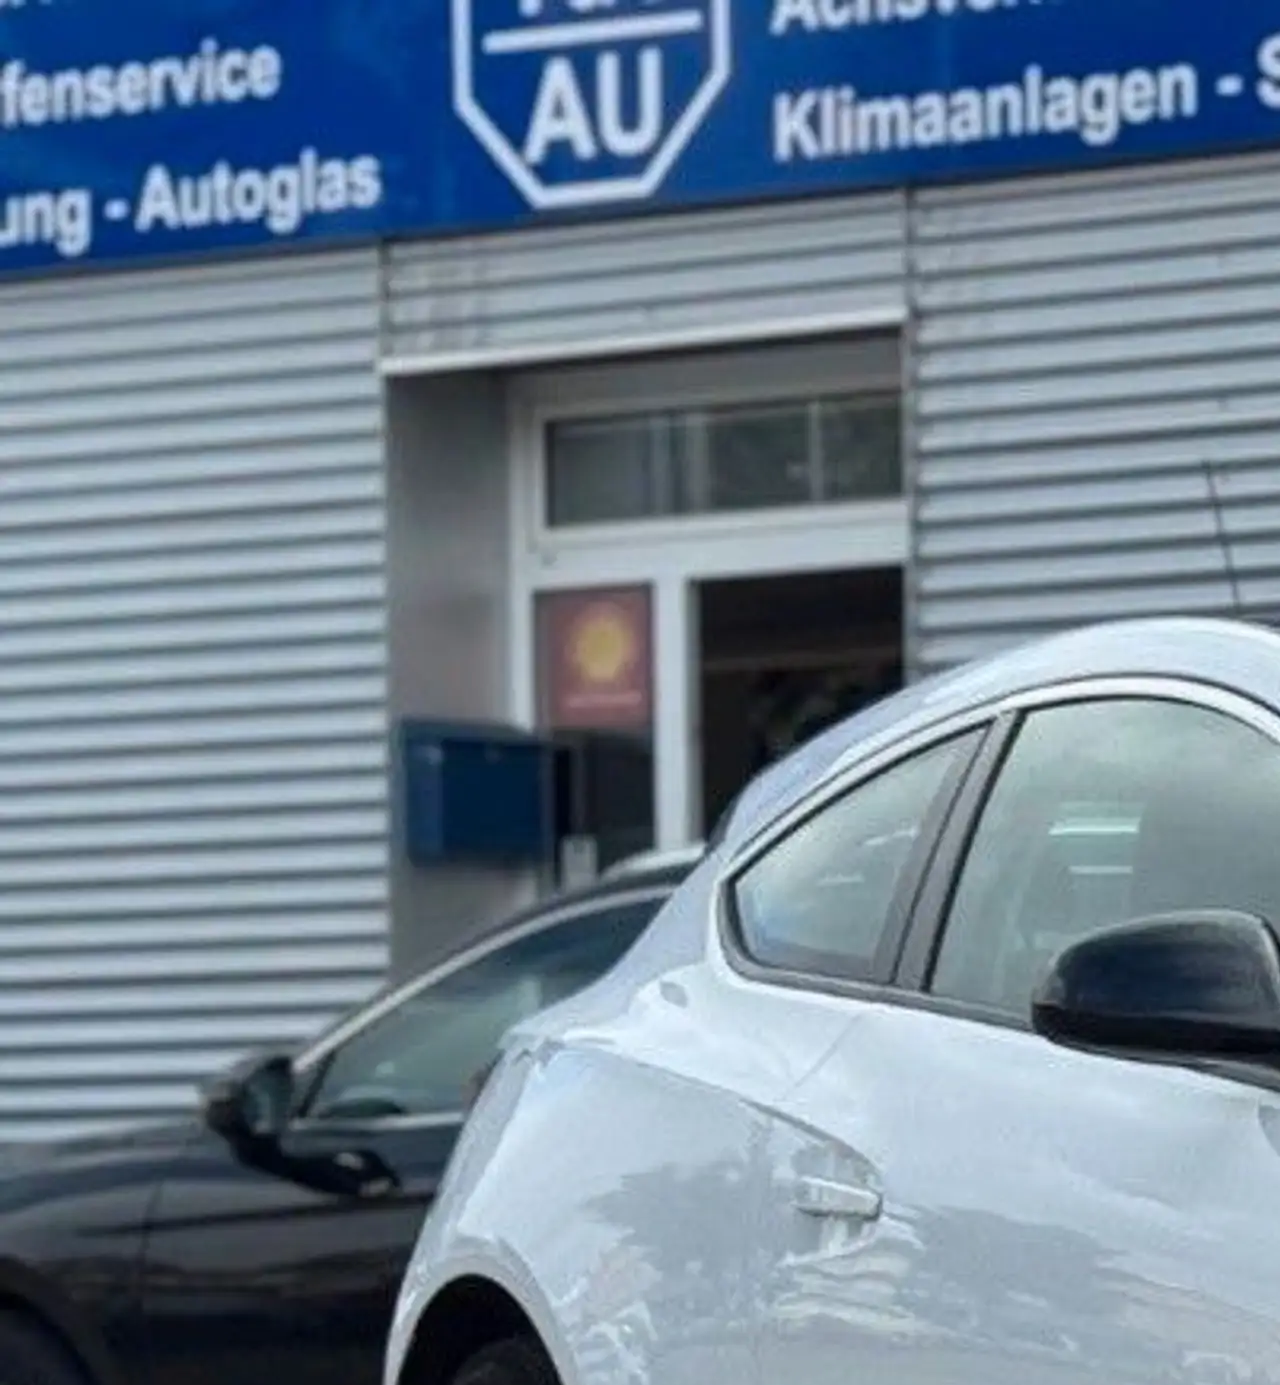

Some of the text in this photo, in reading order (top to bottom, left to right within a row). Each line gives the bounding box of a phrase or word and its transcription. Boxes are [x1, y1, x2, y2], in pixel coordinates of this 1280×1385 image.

[524, 45, 663, 167] AU
[773, 63, 1198, 163] Klimaanlagen
[134, 146, 382, 234] Autoglas
